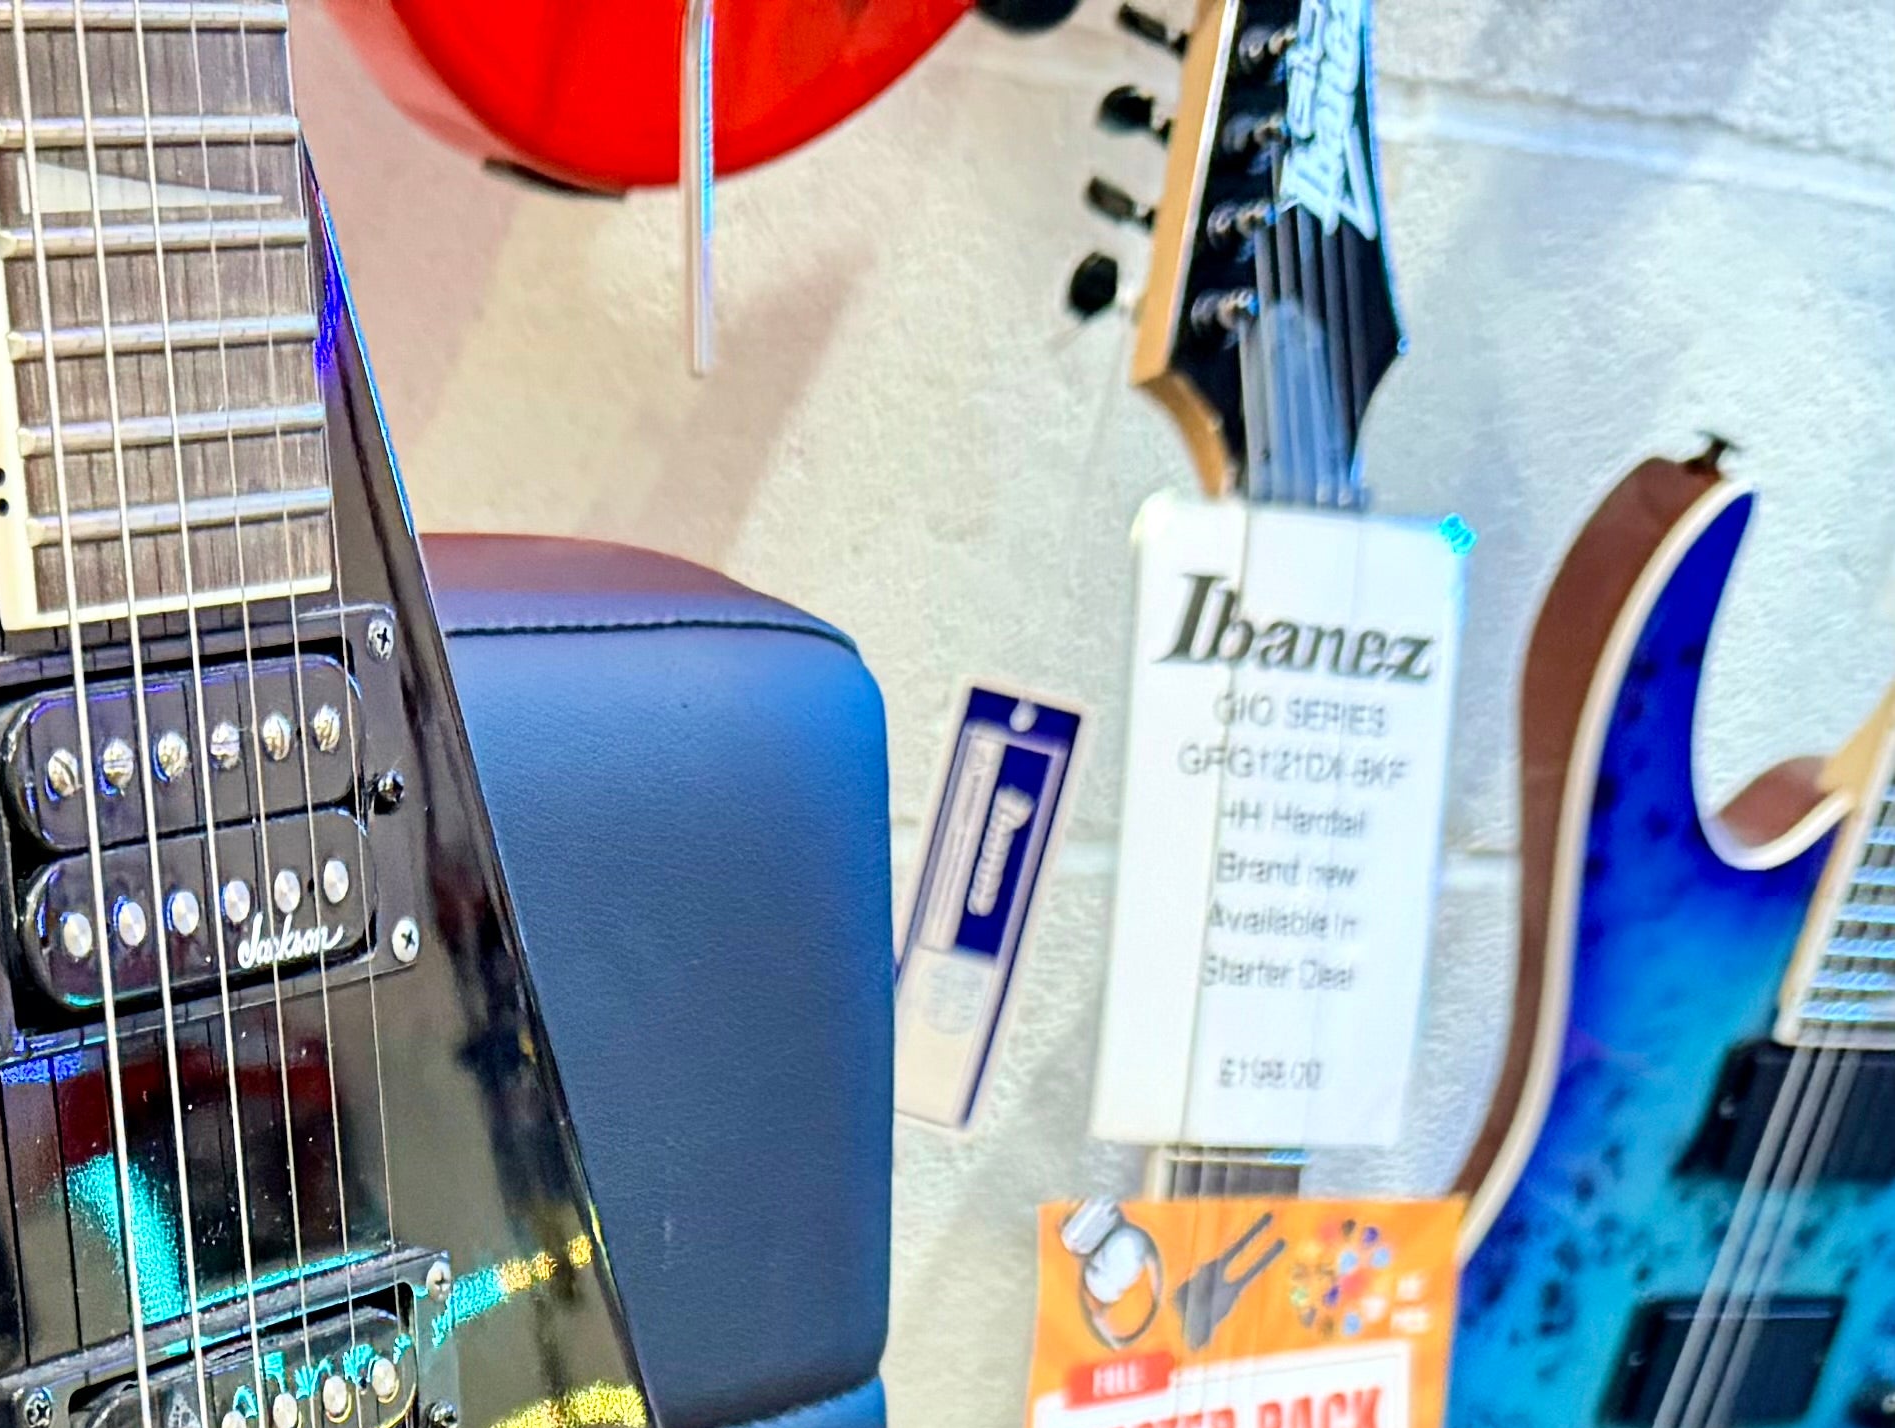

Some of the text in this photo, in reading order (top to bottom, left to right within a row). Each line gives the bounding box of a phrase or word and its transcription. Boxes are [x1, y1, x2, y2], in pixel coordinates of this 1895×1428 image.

[1155, 571, 1435, 683] Ibanez
[1285, 697, 1389, 737] SERIES
[1216, 850, 1300, 886] Brand
[1207, 900, 1328, 938] Available
[238, 911, 344, 969] Jackson
[1201, 951, 1292, 988] Starter
